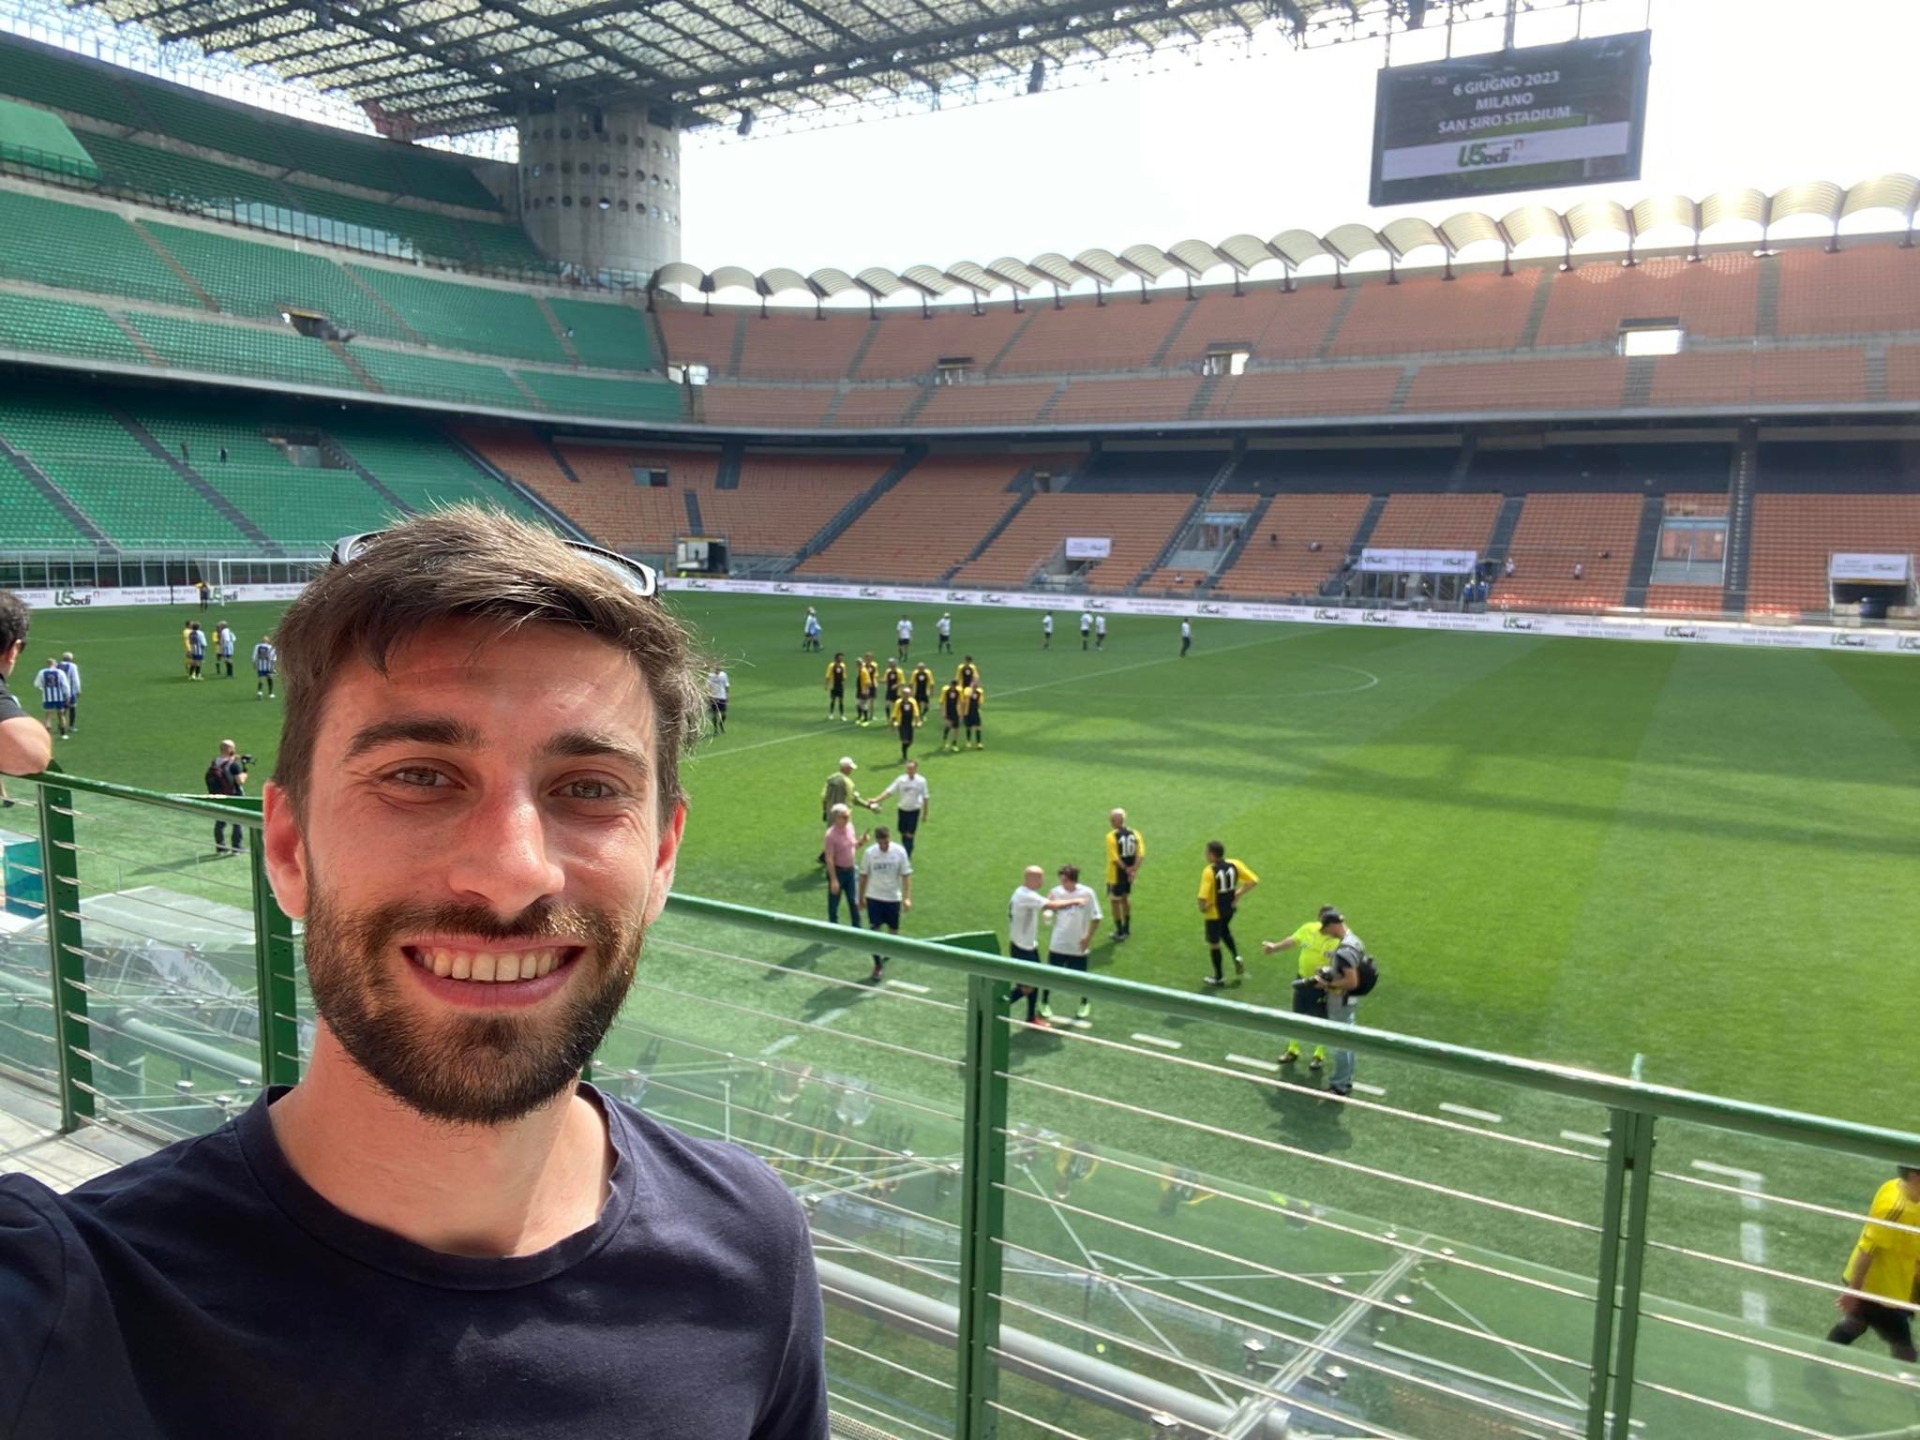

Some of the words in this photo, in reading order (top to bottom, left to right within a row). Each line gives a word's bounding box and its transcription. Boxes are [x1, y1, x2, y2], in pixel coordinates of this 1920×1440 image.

[1453, 83, 1462, 97] 6
[1464, 75, 1522, 95] GIUGNO
[1523, 70, 1560, 87] 2023
[1475, 92, 1534, 111] MILANO
[1438, 119, 1468, 134] SAN
[1469, 113, 1502, 131] SIRO
[1505, 105, 1572, 125] STADIUM
[1118, 833, 1137, 858] 16
[1215, 866, 1235, 893] 11
